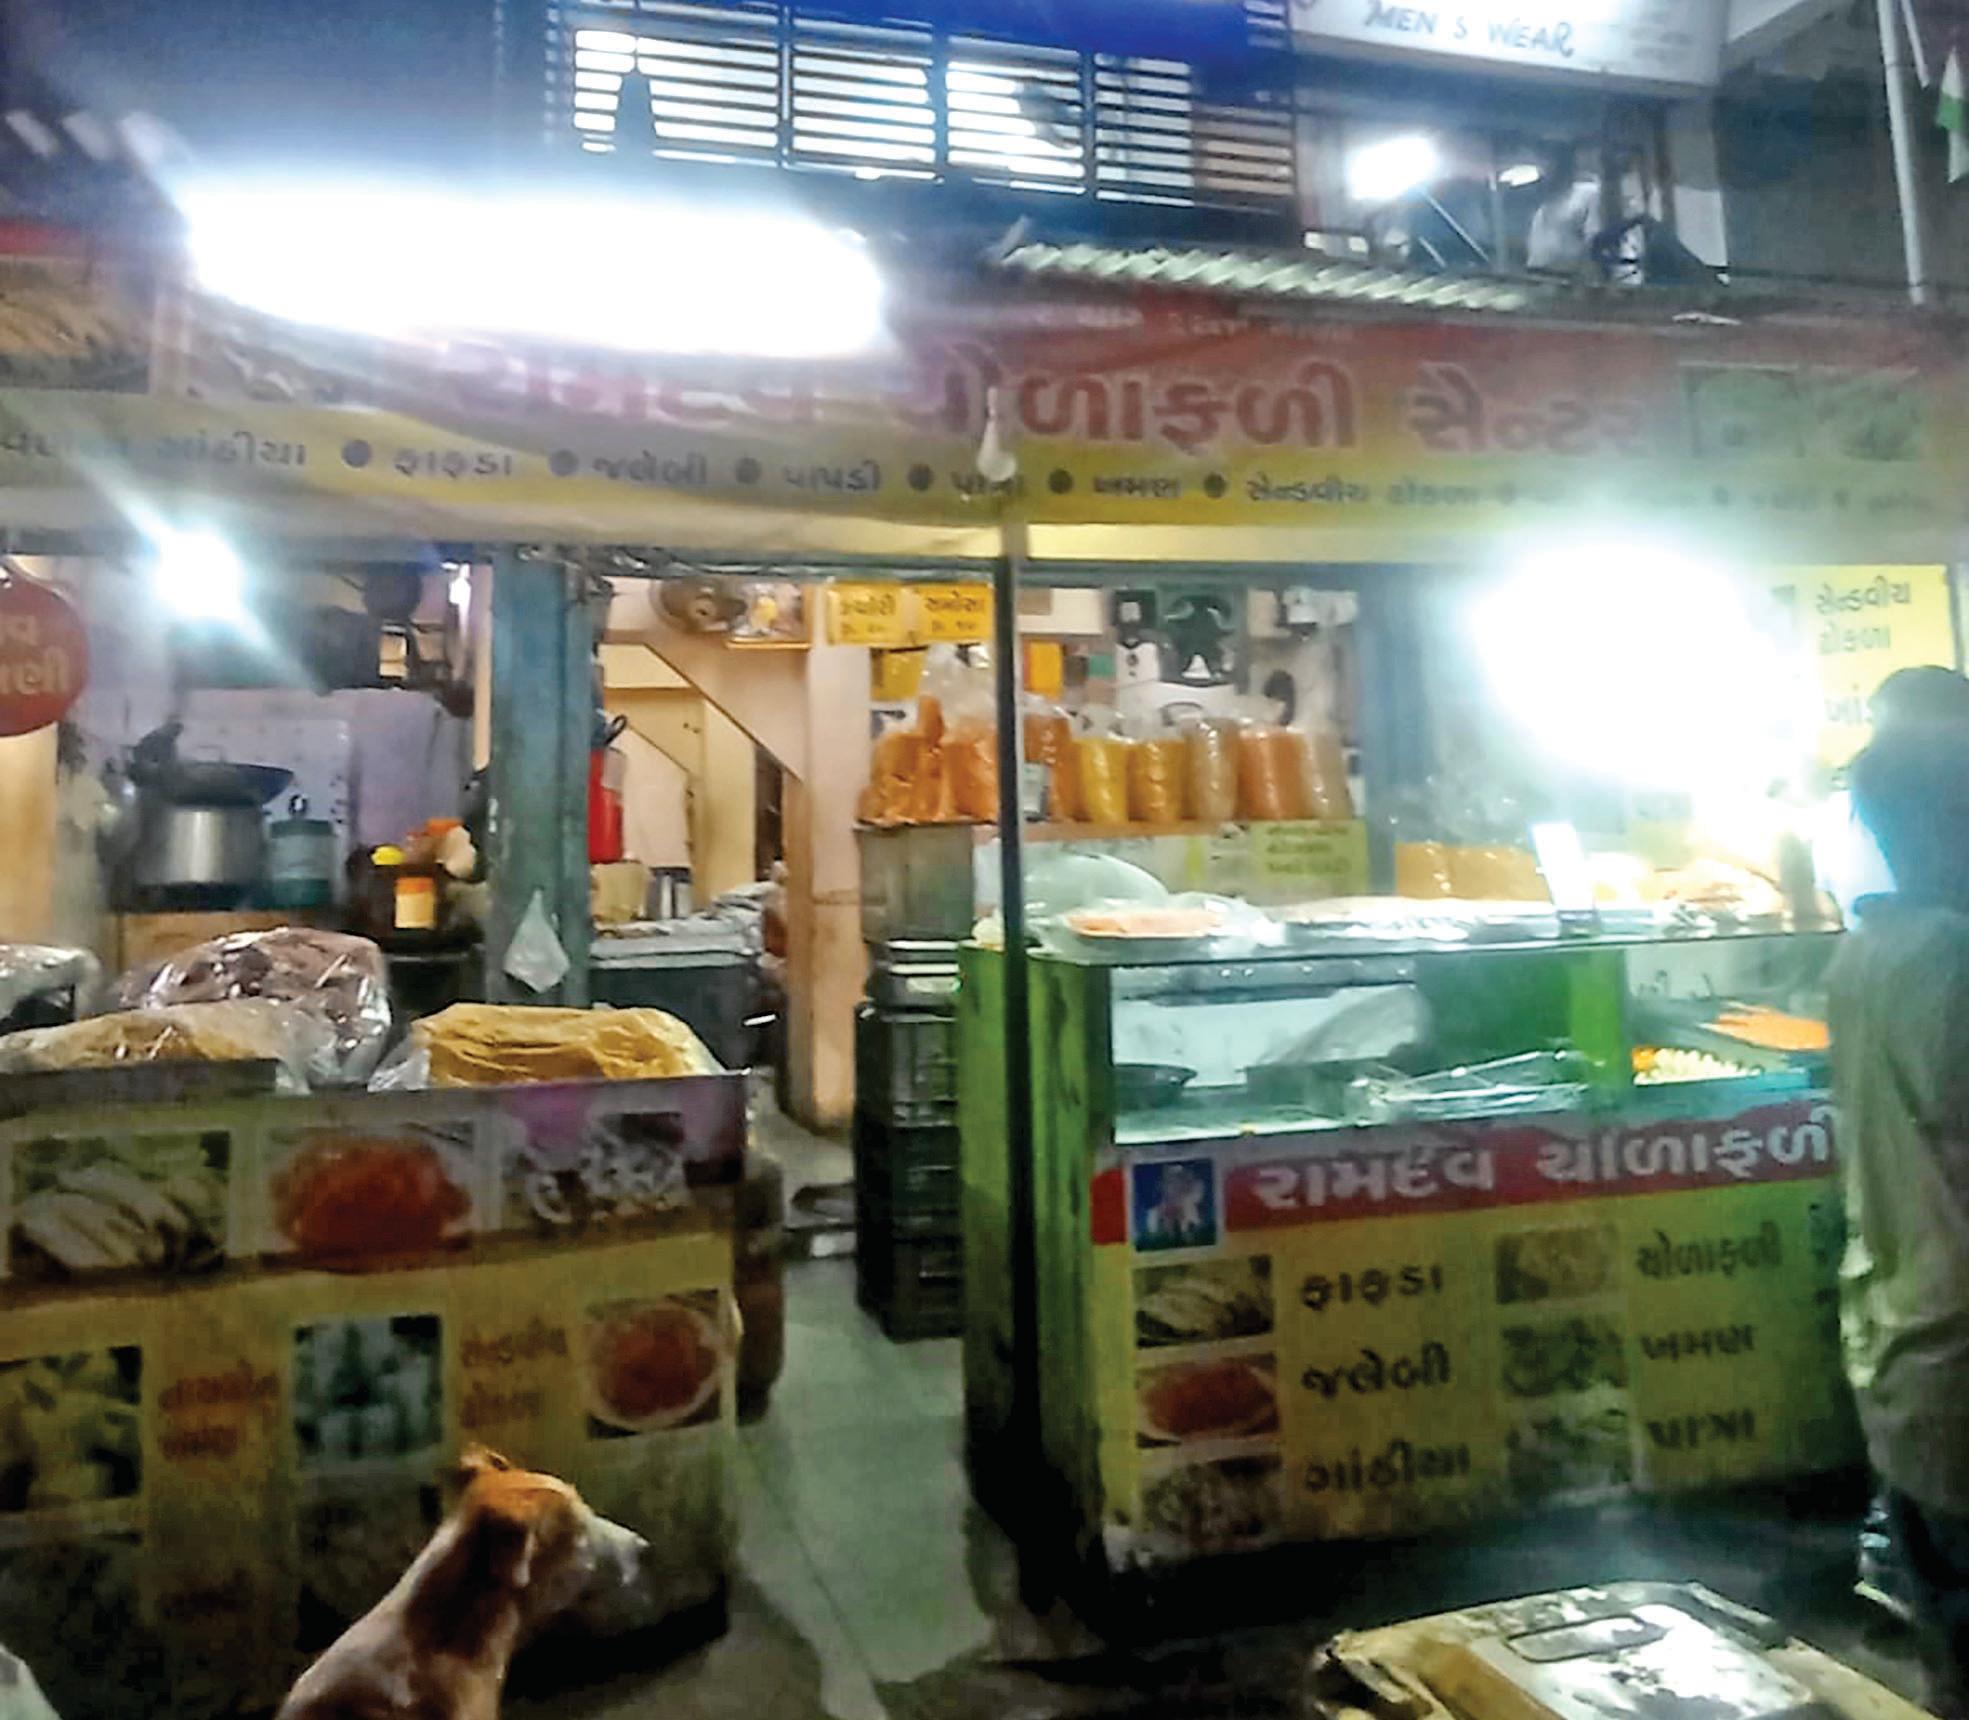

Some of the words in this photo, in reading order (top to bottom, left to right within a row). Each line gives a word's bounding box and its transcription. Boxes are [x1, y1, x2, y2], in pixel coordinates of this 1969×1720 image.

[1365, 0, 1439, 34] MEN
[1488, 19, 1576, 58] WEAR
[1301, 1340, 1452, 1400] જલેબી
